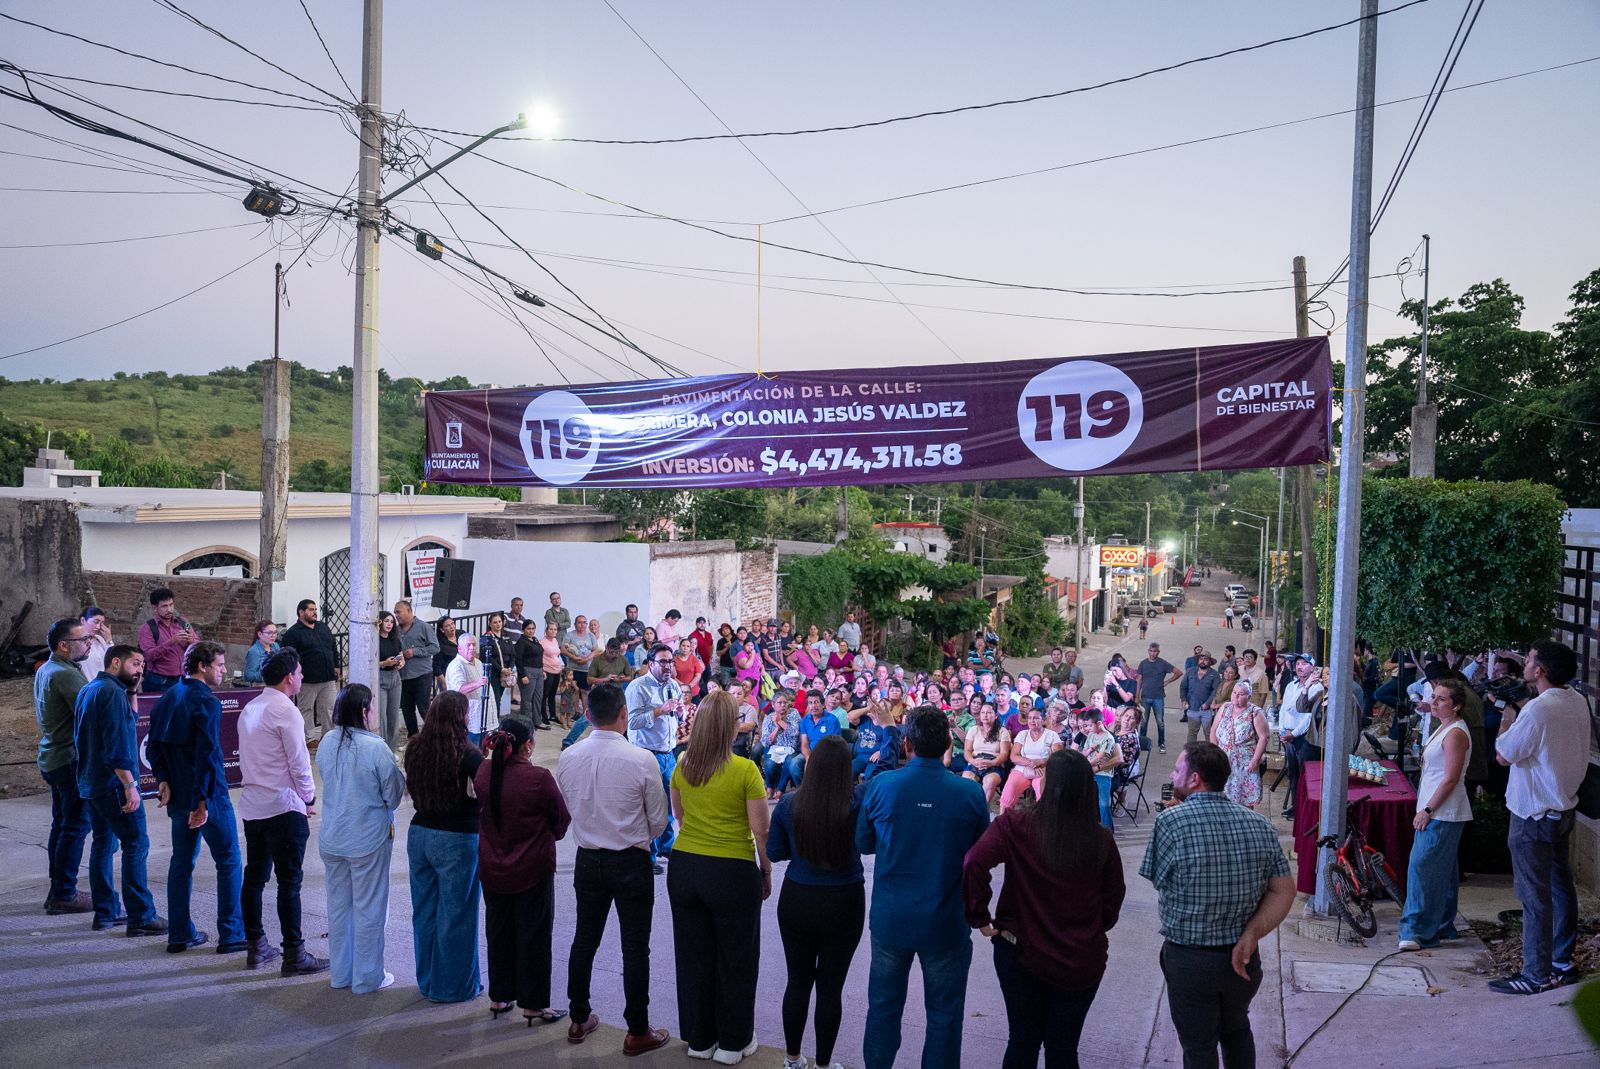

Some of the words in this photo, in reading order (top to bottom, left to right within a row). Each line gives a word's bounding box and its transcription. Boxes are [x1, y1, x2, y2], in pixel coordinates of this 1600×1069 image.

[662, 385, 795, 405] PAVIMENTACIÓN
[801, 385, 824, 398] DE
[830, 384, 853, 397] LA
[858, 382, 922, 395] CALLE:
[1216, 380, 1315, 403] CAPITAL
[637, 412, 719, 431] RIMERA,
[721, 408, 809, 427] COLONIA
[812, 401, 876, 423] JESÚS
[878, 401, 967, 420] VALDEZ
[1025, 390, 1130, 442] 119
[1216, 405, 1236, 416] DE
[1238, 399, 1316, 414] BIENESTAR
[525, 416, 593, 460] 119
[432, 460, 479, 469] CULIACÁN
[641, 453, 756, 475] INVERSIÓN:
[759, 443, 963, 476] $4,474,311.58
[1102, 551, 1137, 562] OXXO
